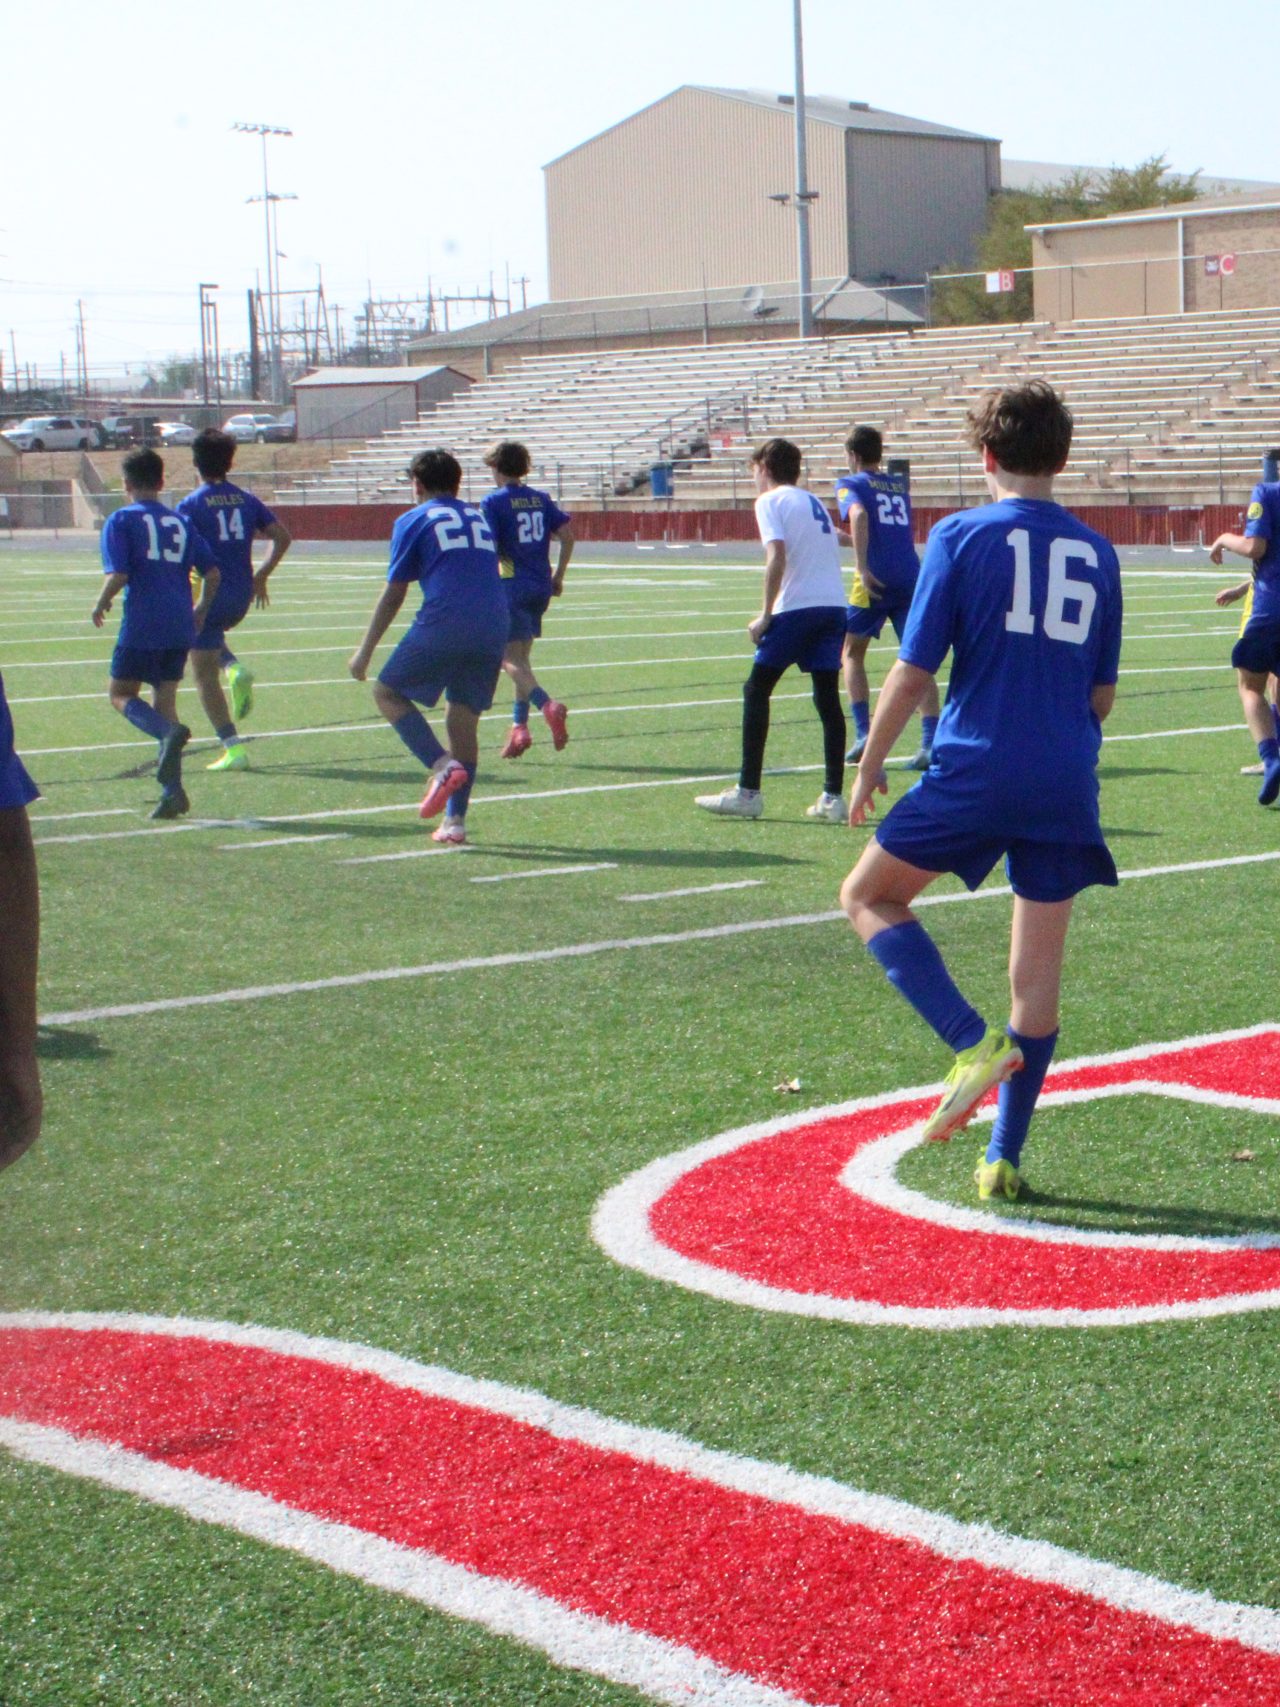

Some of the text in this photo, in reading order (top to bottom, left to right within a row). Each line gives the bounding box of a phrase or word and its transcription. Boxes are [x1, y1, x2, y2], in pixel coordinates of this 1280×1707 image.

[1220, 255, 1234, 275] C
[1002, 272, 1012, 291] B
[205, 494, 245, 507] MULES
[808, 495, 831, 534] 4
[876, 493, 909, 526] 23
[142, 513, 187, 563] 13
[216, 508, 245, 540] 14
[427, 507, 496, 552] 22
[516, 511, 544, 543] 20
[1005, 528, 1098, 645] 16
